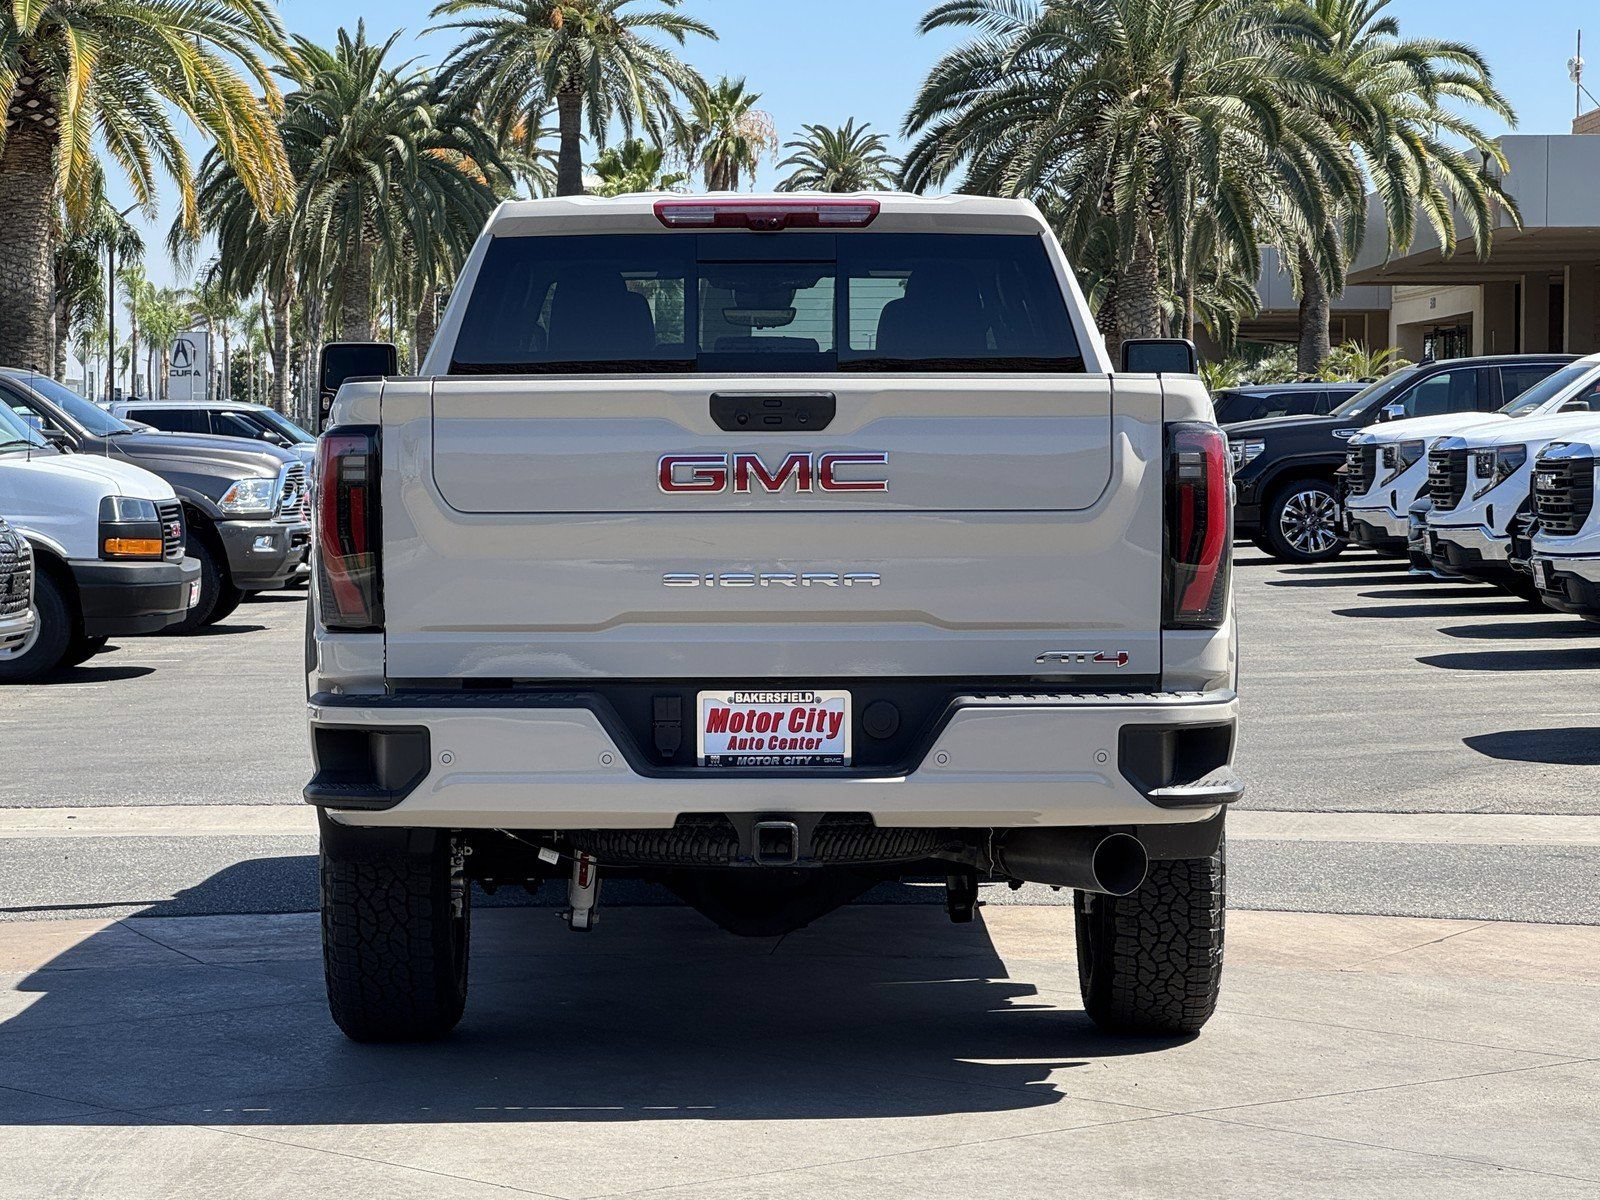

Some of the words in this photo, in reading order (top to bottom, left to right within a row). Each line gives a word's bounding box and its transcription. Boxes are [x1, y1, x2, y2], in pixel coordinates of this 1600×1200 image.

[169, 369, 201, 377] CURA
[657, 452, 889, 494] GMC
[662, 572, 881, 588] SIERRA
[1035, 650, 1129, 668] AT4
[735, 692, 814, 703] BAKERSFIELD
[705, 707, 785, 734] Motor
[787, 707, 844, 740] City
[726, 735, 765, 751] Auto
[767, 735, 824, 751] Center
[736, 756, 781, 766] MOTOR
[782, 756, 813, 766] CITY
